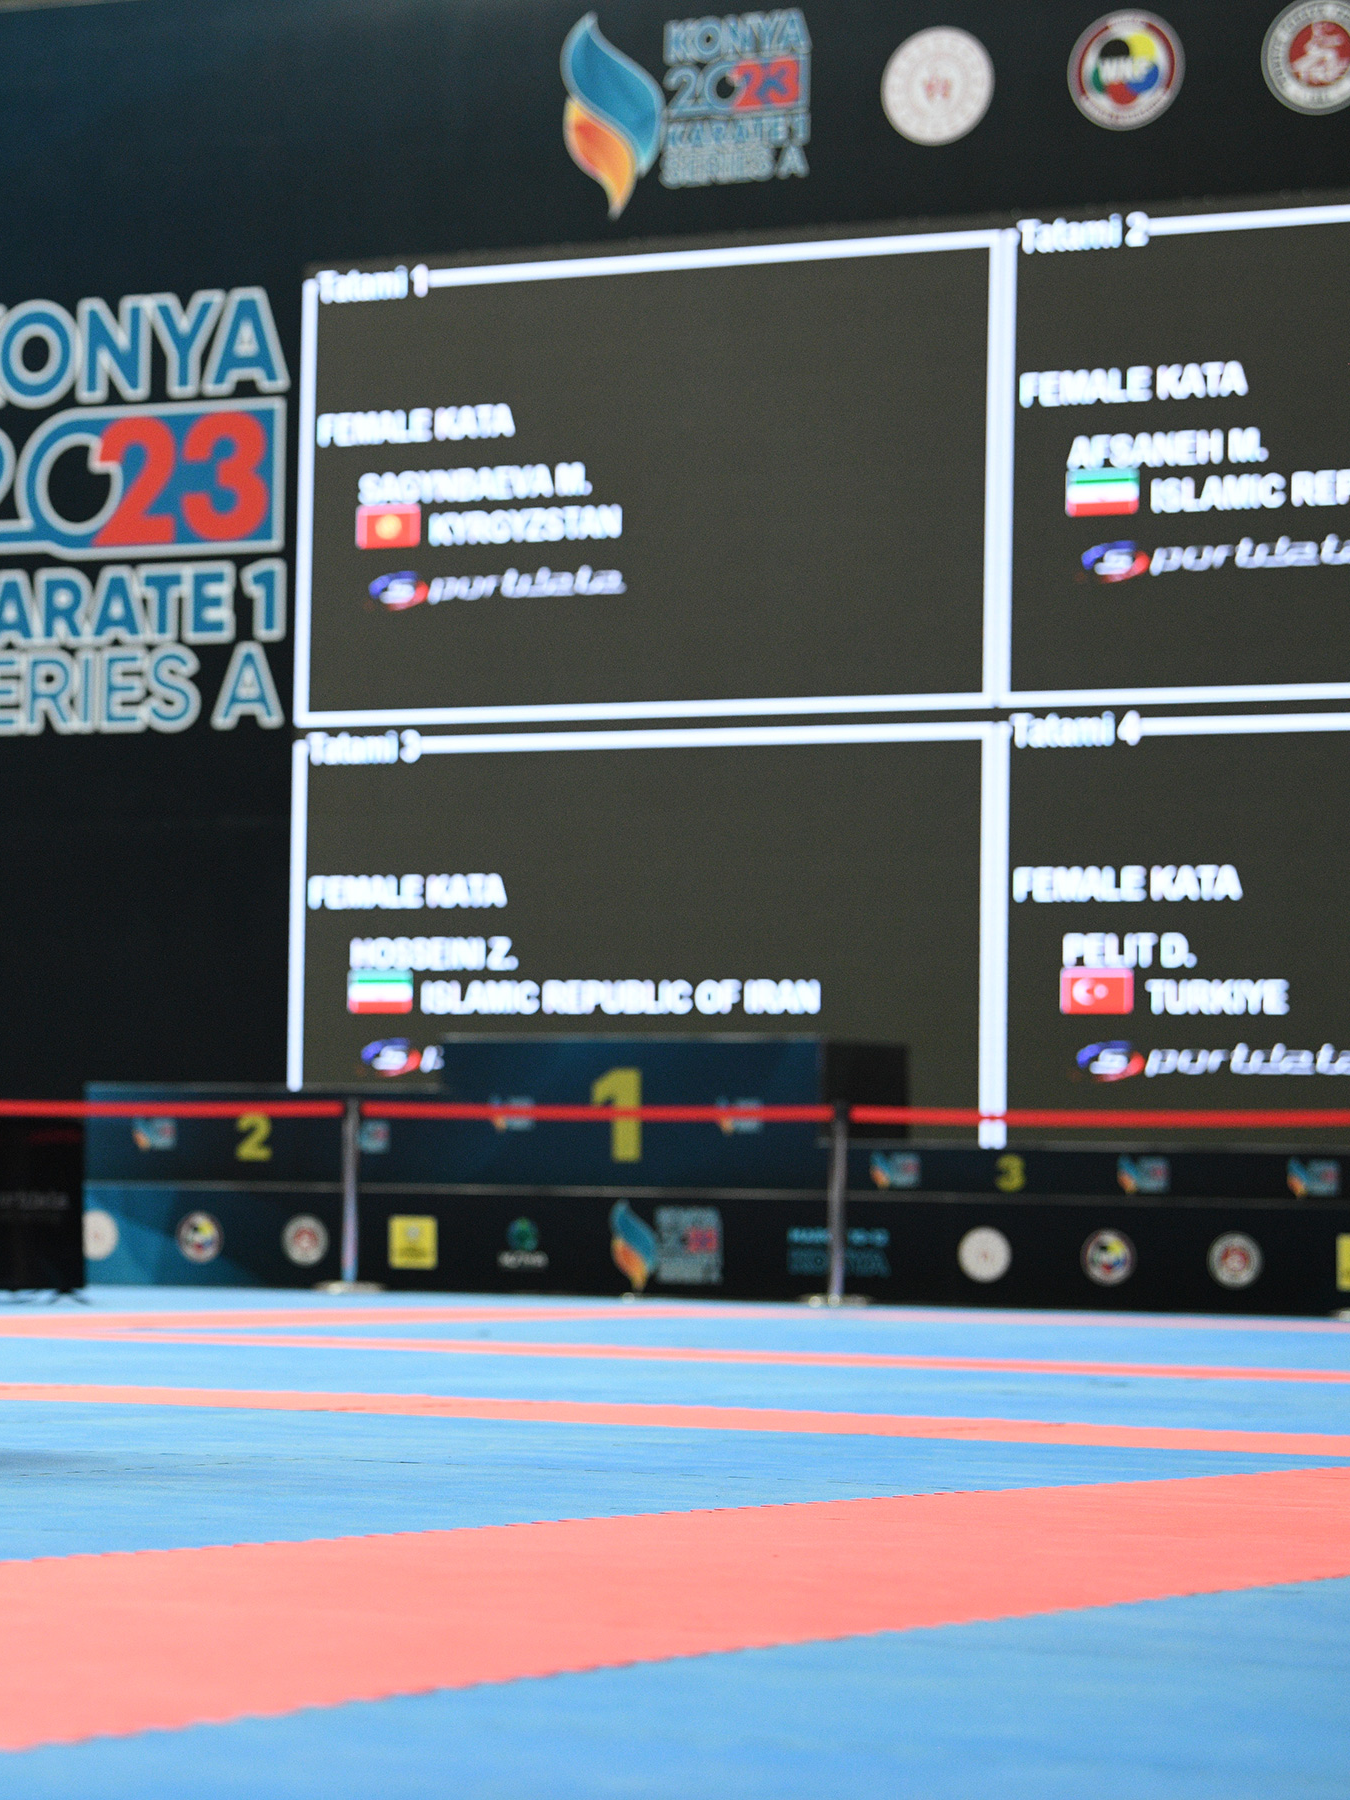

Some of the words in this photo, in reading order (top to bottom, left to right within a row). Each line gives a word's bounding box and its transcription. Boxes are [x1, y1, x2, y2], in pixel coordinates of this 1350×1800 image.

[663, 7, 813, 66] KONYA
[663, 54, 811, 121] 2023
[1016, 213, 1122, 254] Tatami
[1125, 211, 1150, 247] 2
[316, 265, 408, 304] Tatami
[410, 263, 429, 298] 1
[1019, 365, 1152, 408] FEMALE
[1156, 361, 1248, 400] KATA
[316, 407, 433, 448] FEMALE
[434, 403, 516, 441] KATA
[1066, 429, 1224, 469] AFSANEH
[1228, 426, 1269, 463] M.
[1151, 473, 1286, 514] ISLAMIC
[240, 559, 286, 642] 1
[211, 641, 285, 731] A
[305, 729, 398, 766] Tatami
[400, 729, 422, 764] 3
[1009, 711, 1115, 748] Tatami
[1117, 710, 1142, 746] 4
[307, 874, 425, 910] FEMALE
[426, 873, 508, 909] KATA
[1013, 865, 1146, 903] FEMALE
[1150, 864, 1243, 901] KATA
[1062, 932, 1158, 968] PELIT
[1160, 932, 1197, 968] D.
[420, 979, 540, 1015] ISLAMIC
[542, 979, 693, 1015] REPUBLIC
[694, 979, 742, 1015] OF
[743, 979, 821, 1015] IRAN
[591, 1067, 642, 1163] 1
[235, 1112, 272, 1162] 2
[995, 1153, 1026, 1193] 3
